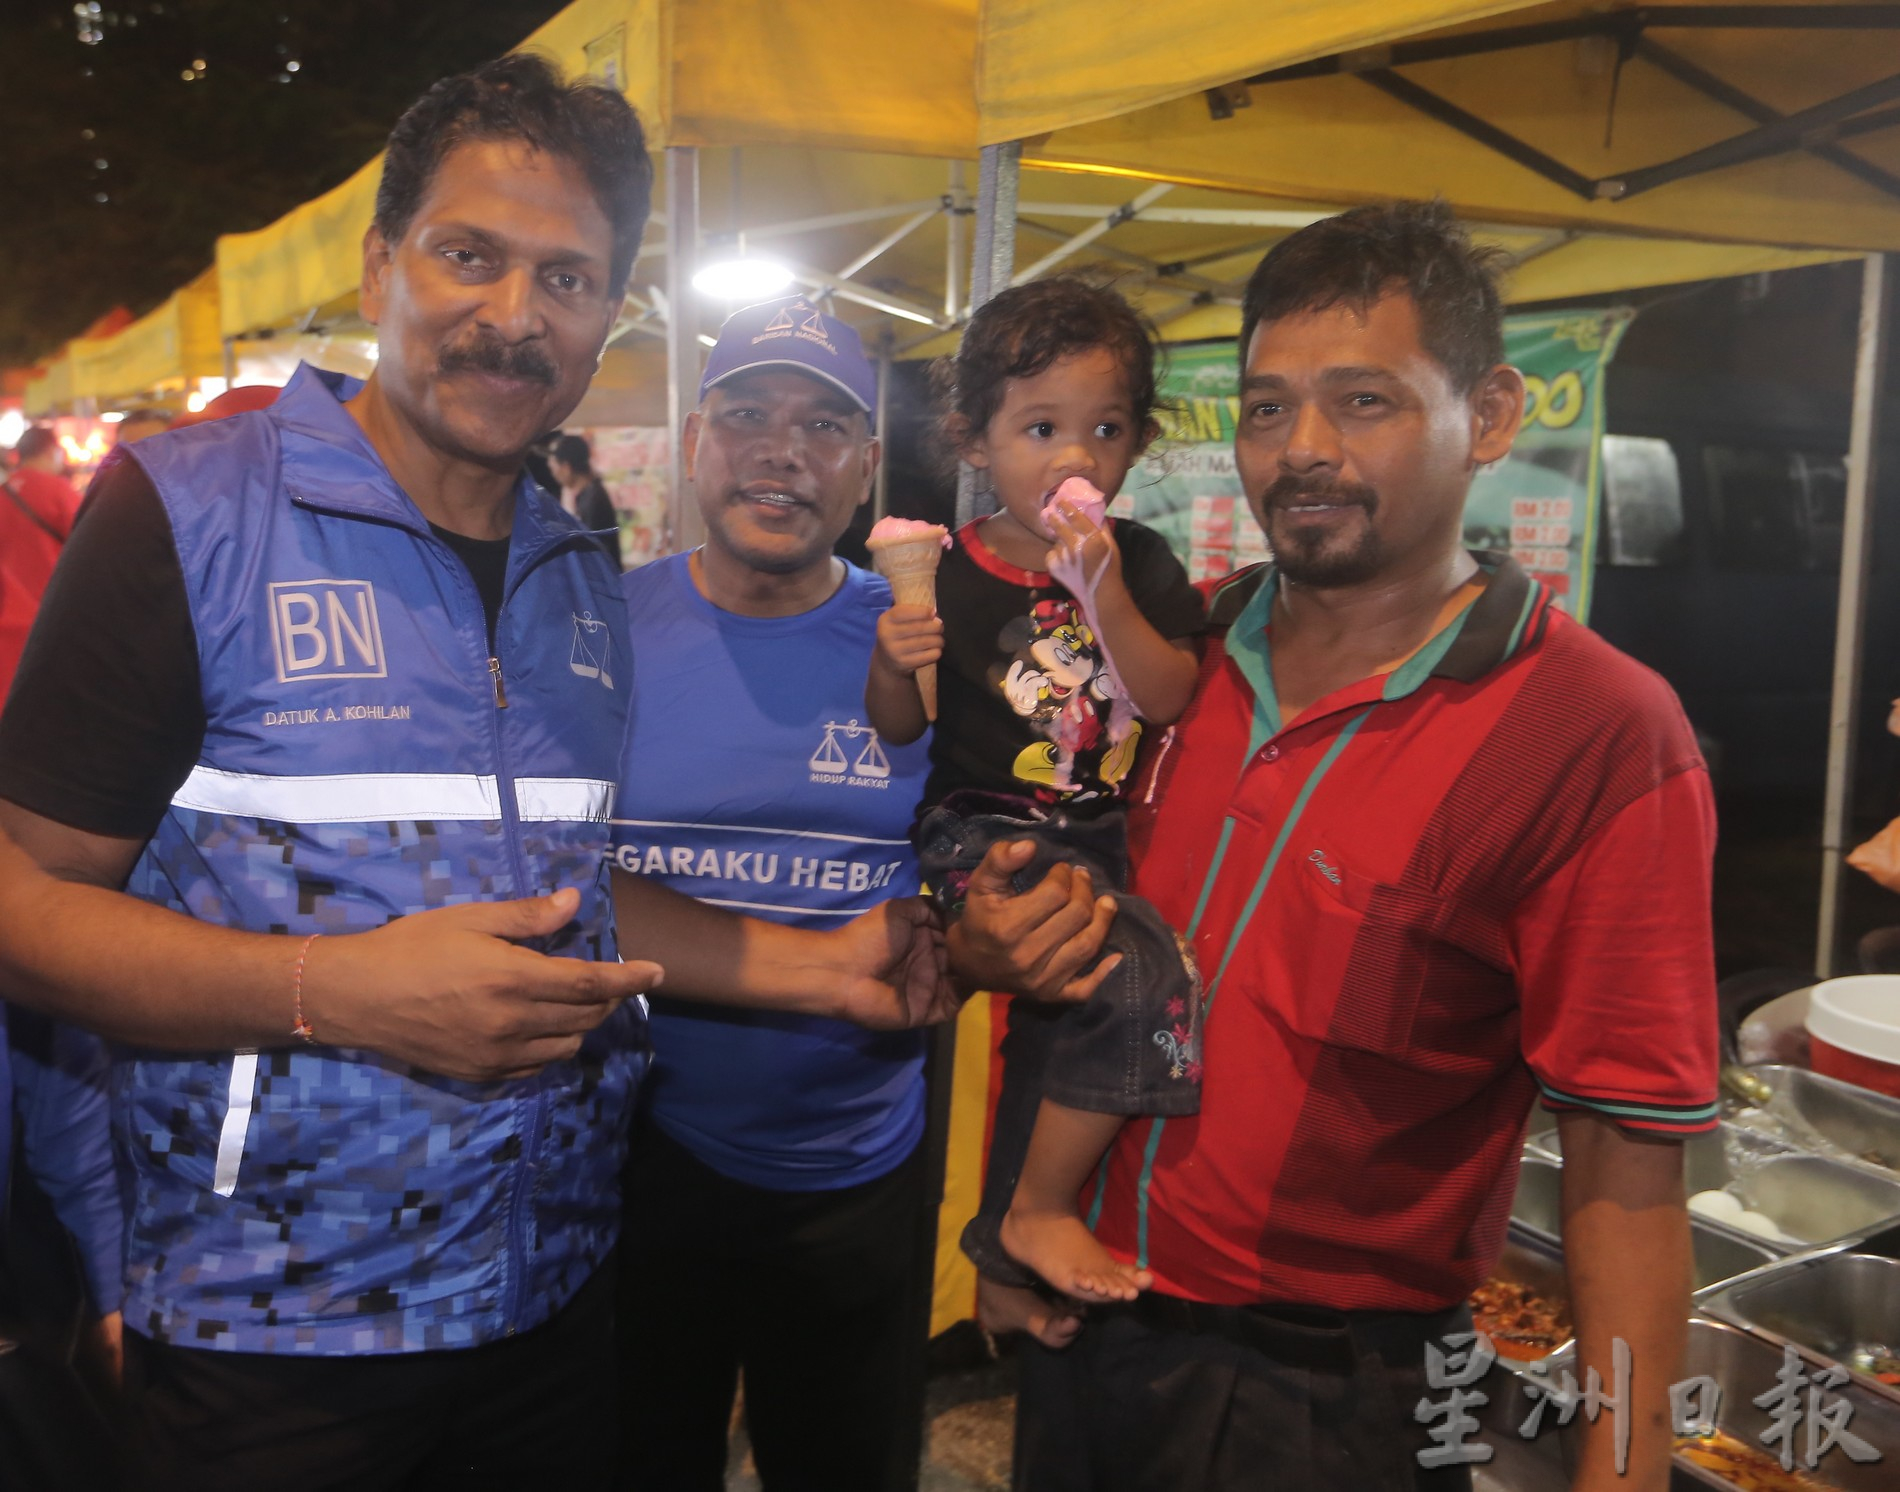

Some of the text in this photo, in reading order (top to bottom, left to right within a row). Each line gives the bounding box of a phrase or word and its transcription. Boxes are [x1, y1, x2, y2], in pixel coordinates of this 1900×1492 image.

[278, 590, 376, 671] BN
[264, 705, 411, 726] DATUK A. KOHILAN
[810, 773, 890, 790] HIDUP RAKYAT
[790, 856, 902, 892] HEBAT
